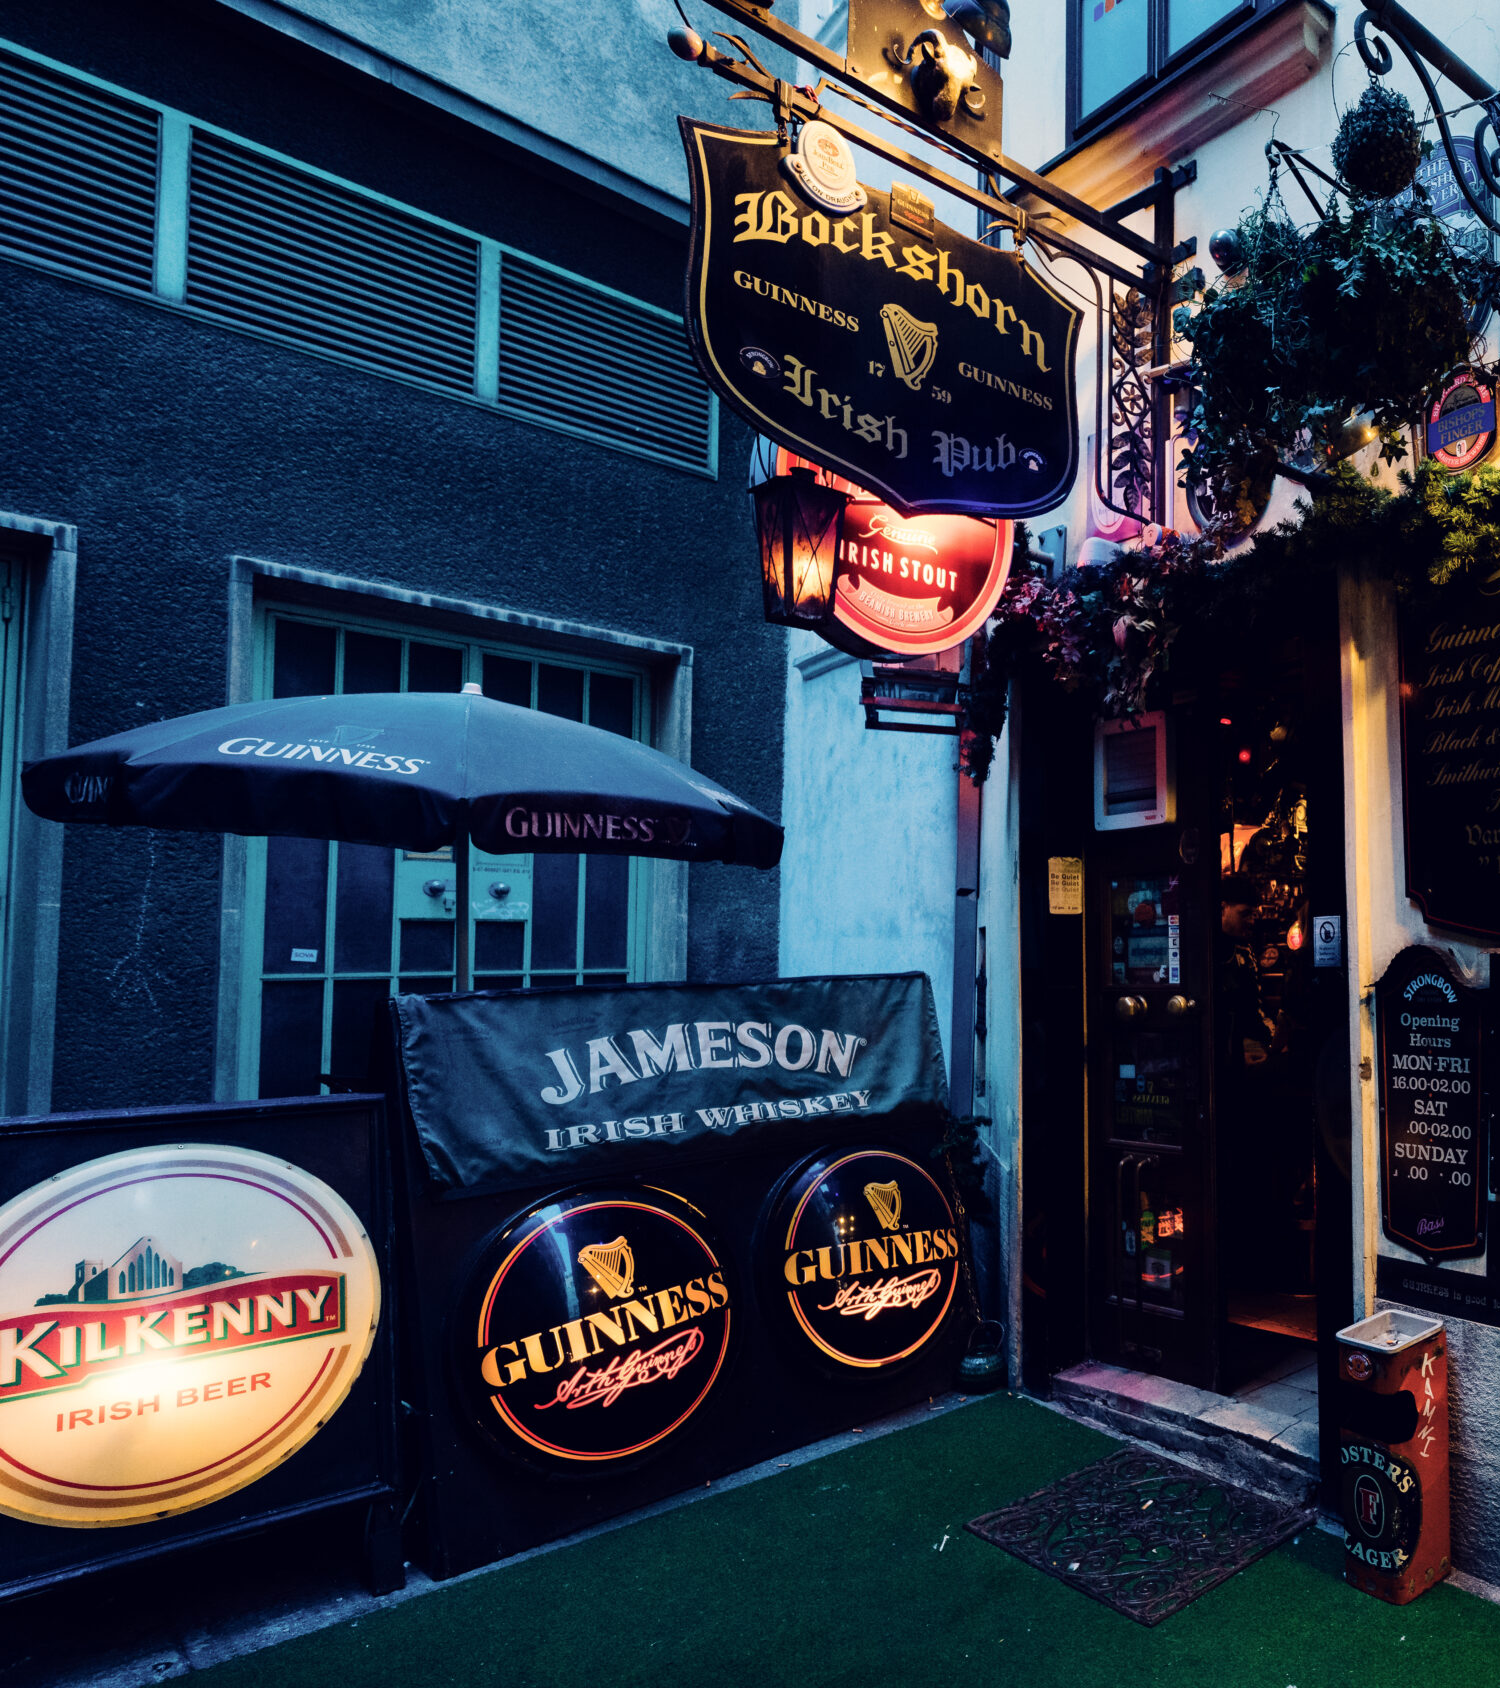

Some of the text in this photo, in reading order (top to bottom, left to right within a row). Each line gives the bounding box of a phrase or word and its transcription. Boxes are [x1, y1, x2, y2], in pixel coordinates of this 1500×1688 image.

[732, 190, 1052, 373] Bockshorn
[733, 270, 860, 333] GUINNESS
[867, 360, 886, 378] 17
[931, 386, 953, 405] 59
[958, 361, 1053, 412] GUINNESS
[783, 354, 908, 459] Irish
[1437, 406, 1485, 432] BISHOPS
[1440, 420, 1483, 445] FINGER
[931, 430, 1017, 478] Pub
[839, 538, 957, 592] IRISH STOUT
[859, 591, 895, 618] BEAMISH
[899, 607, 934, 622] BREWERY
[1420, 662, 1465, 689] Irish
[1425, 692, 1471, 720] Irish
[217, 736, 425, 775] GUINNESS
[1423, 729, 1479, 755] Black
[505, 806, 654, 842] GUINNESS
[1403, 973, 1458, 1004] STRONGBOW
[1400, 1012, 1460, 1032] Opening
[1409, 1033, 1451, 1049] Hours
[541, 1021, 863, 1106] JAMESON
[1392, 1054, 1471, 1074] MON-FRI
[1392, 1076, 1471, 1095] 16.00-02.00
[545, 1089, 872, 1152] IRISH WHISKEY
[1414, 1100, 1448, 1117] SAT
[1394, 1143, 1469, 1165] SUNDAY
[1416, 1216, 1445, 1235] Bass
[784, 1227, 959, 1286] GUINNESS
[0, 1285, 332, 1388] KILKENNY
[481, 1270, 729, 1388] GUINNESS
[56, 1372, 272, 1432] IRISH BEER
[1359, 1487, 1380, 1525] F
[1344, 1529, 1409, 1569] LAGER
